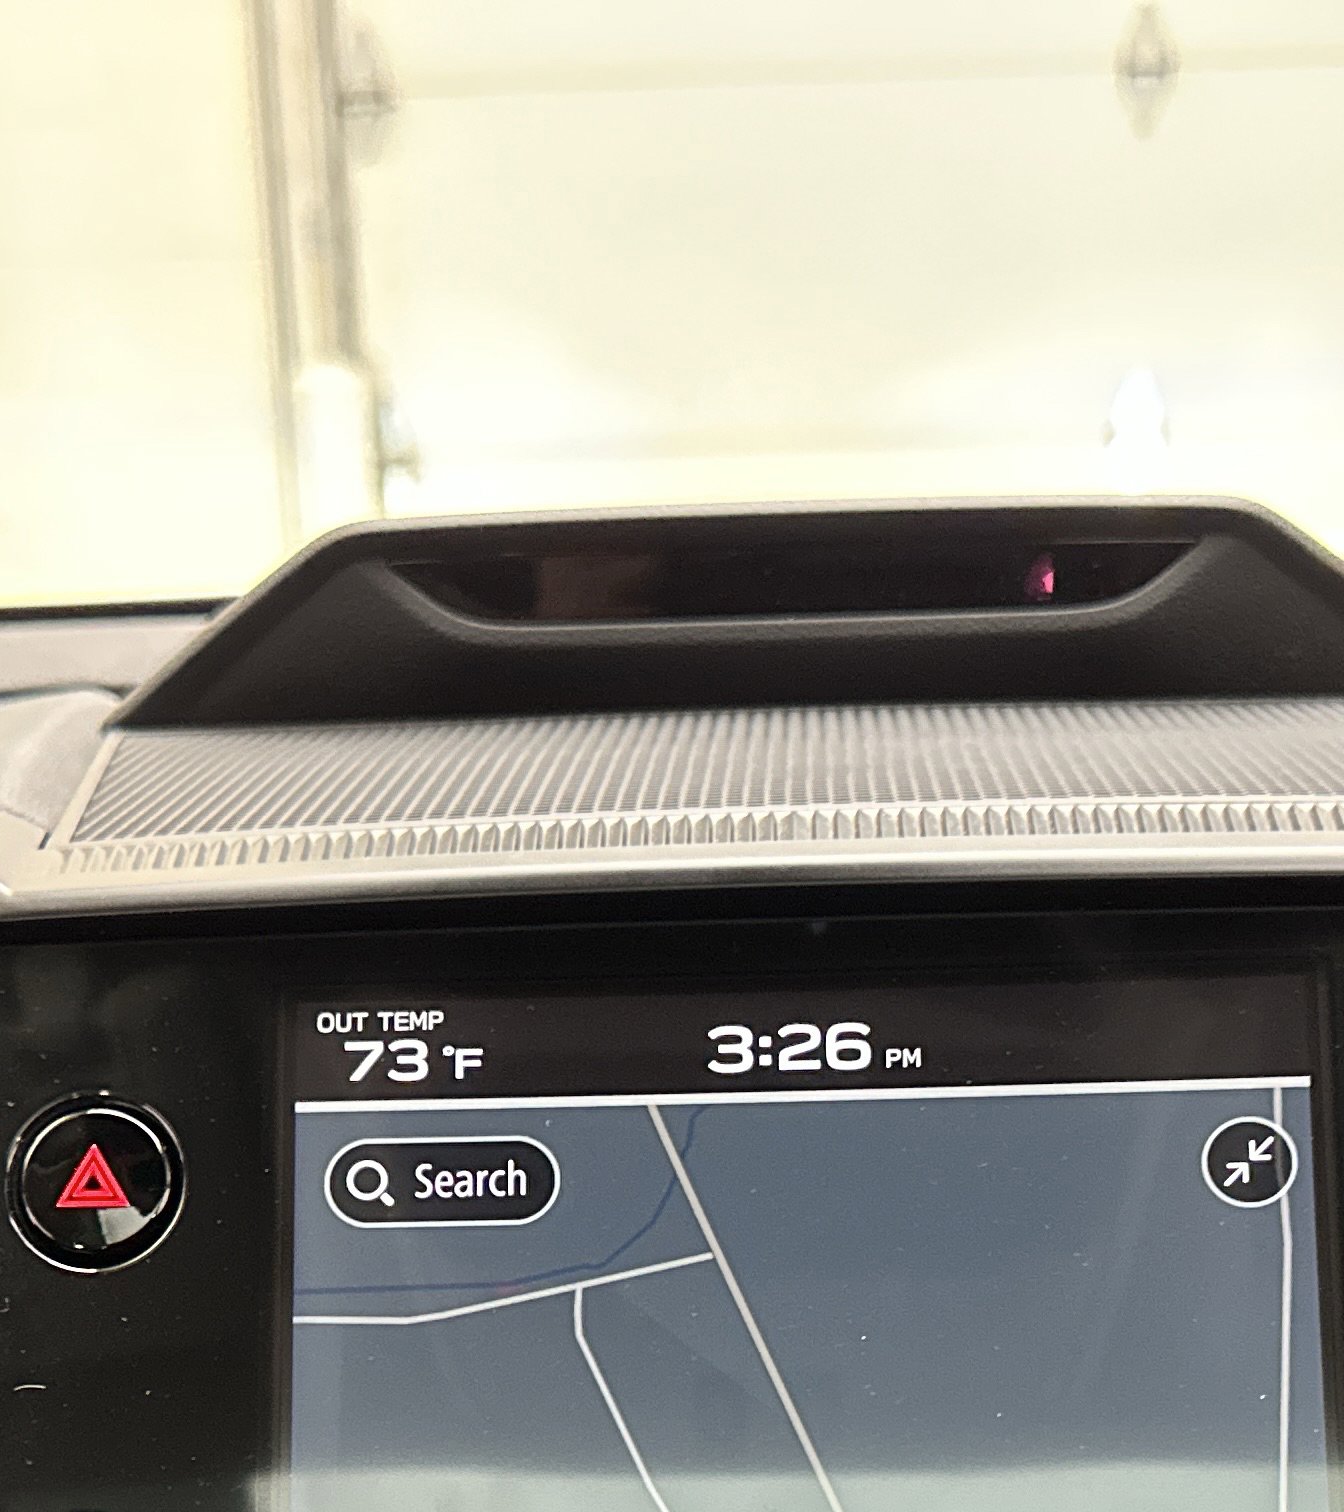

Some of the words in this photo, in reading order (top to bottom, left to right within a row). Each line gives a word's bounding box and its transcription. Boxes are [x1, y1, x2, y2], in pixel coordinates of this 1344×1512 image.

[316, 1012, 369, 1034] OUT
[379, 1010, 445, 1032] TEMP
[343, 1038, 430, 1083] 73
[706, 1022, 873, 1075] 3:26
[885, 1047, 923, 1070] PM
[414, 1160, 528, 1200] Search
